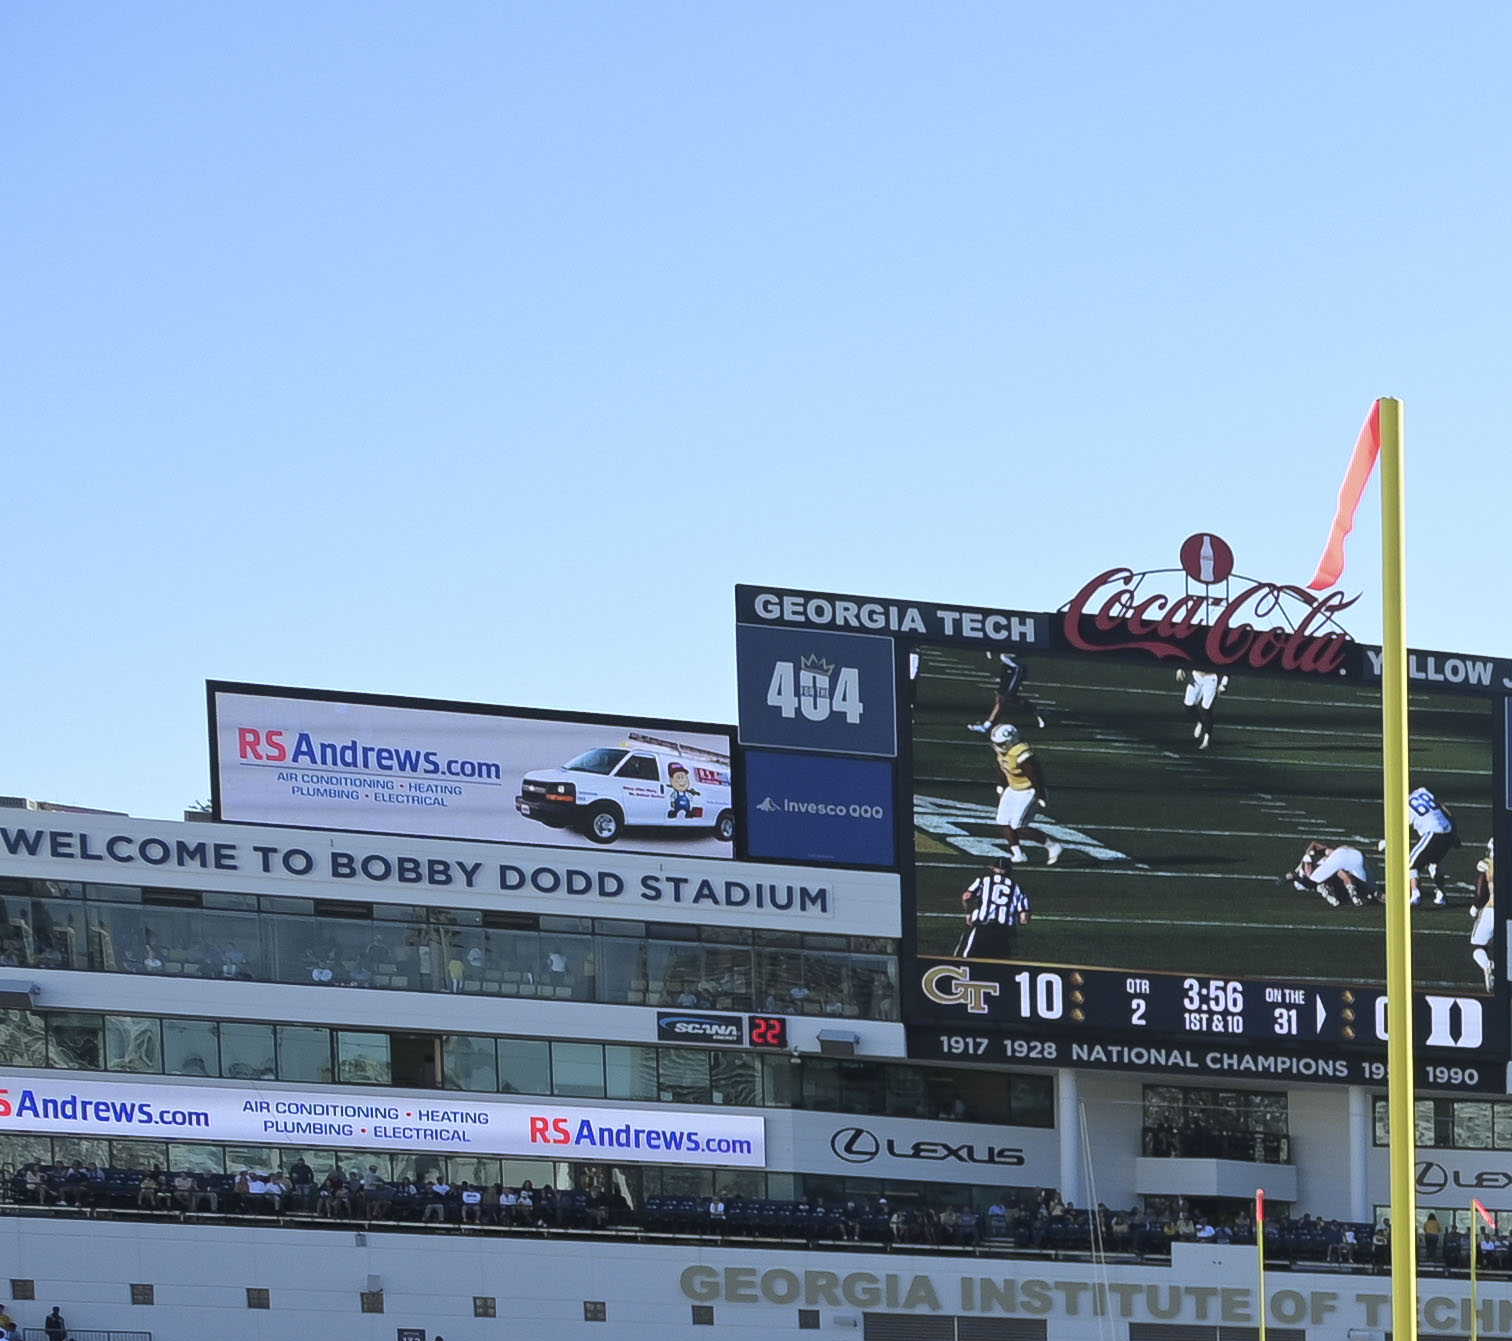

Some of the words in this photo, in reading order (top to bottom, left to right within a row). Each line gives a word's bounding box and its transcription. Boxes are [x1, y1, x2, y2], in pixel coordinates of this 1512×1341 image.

[755, 594, 927, 634] GEORGIA
[937, 611, 1035, 642] TECH
[1367, 651, 1493, 686] YLLOW
[277, 772, 298, 782] AIR
[301, 773, 394, 790] CONDITIONING
[408, 783, 463, 795] HEATING
[292, 786, 359, 800] PLUMBING
[374, 792, 448, 807] ELECTRICAL
[784, 798, 846, 816] Invesco
[0, 827, 239, 871] WELCOME
[253, 845, 314, 875] TO
[331, 851, 482, 888] BOBBY
[499, 864, 625, 898] DODD
[640, 875, 828, 913] STADIUM
[1014, 971, 1063, 1020] 10
[1126, 978, 1150, 995] QTR
[1183, 978, 1243, 1013] 3:56
[1265, 987, 1283, 1003] ON
[1285, 989, 1305, 1005] THE
[1131, 998, 1147, 1026] 2
[1184, 1012, 1209, 1031] 1ST
[1226, 1015, 1243, 1034] 10
[1274, 1008, 1298, 1035] 31
[752, 1018, 782, 1044] 22
[940, 1035, 989, 1055] 1917
[1003, 1040, 1057, 1059] 1928
[1072, 1043, 1199, 1068] NATIONAL
[1206, 1052, 1349, 1077] CHAMPIONS
[1426, 1066, 1479, 1085] 1990
[243, 1100, 270, 1113] AIR
[276, 1102, 399, 1120] CONDITIONING
[418, 1110, 489, 1125] HEATING
[264, 1120, 353, 1136] PLUMBING
[373, 1126, 471, 1142] ELECTRICAL
[887, 1139, 1025, 1166] LEXUS
[680, 1265, 941, 1311] GEORGIA
[961, 1276, 1254, 1323] INSTITUTE
[1270, 1290, 1337, 1325] OF
